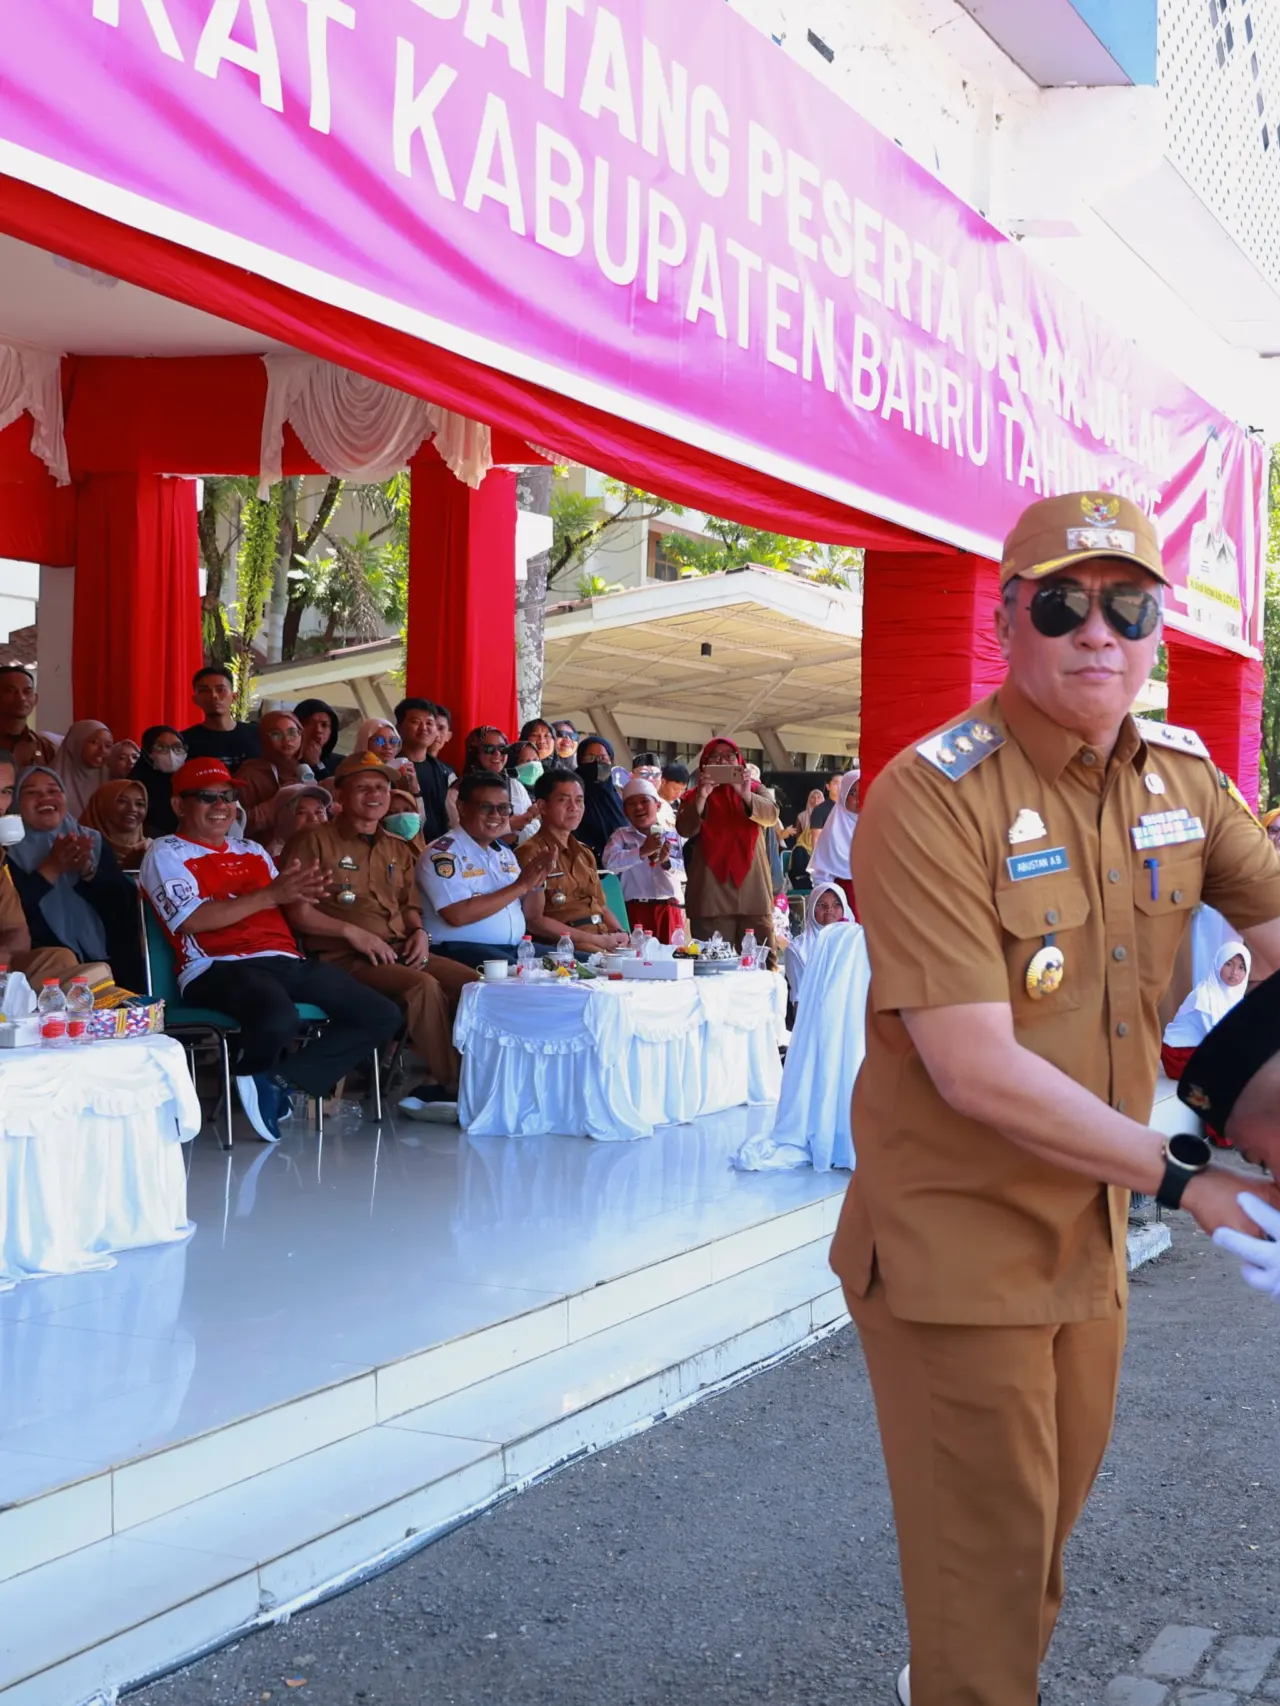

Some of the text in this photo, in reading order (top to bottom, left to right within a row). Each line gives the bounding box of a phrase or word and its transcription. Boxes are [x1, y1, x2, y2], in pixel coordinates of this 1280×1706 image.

[393, 36, 836, 392] KABUPATEN
[852, 313, 989, 466] BARRU
[411, 0, 1171, 482] ATANG PESERTA GERAK JALAN
